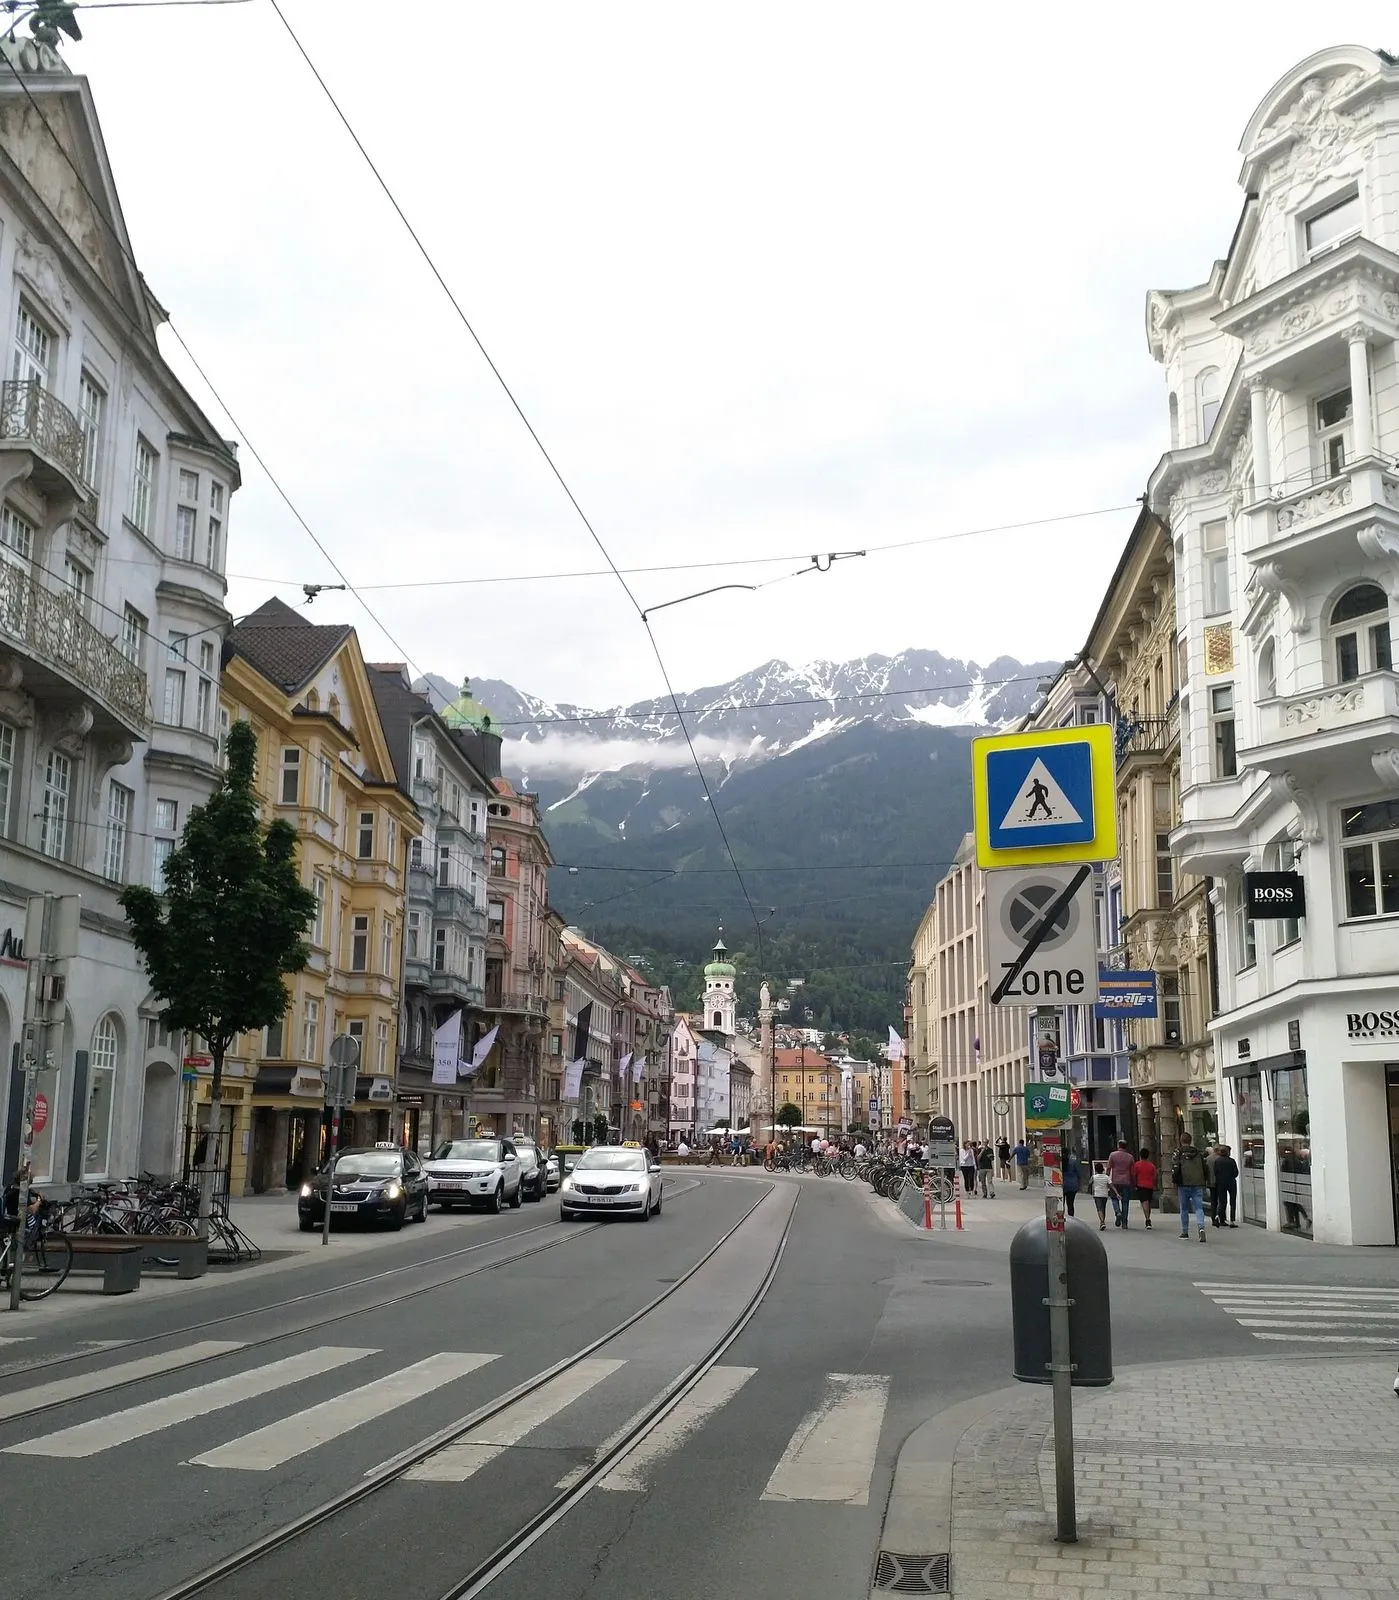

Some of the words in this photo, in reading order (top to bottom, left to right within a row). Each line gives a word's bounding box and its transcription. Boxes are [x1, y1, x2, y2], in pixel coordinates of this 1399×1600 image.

[1254, 887, 1294, 899] BOSS
[1001, 962, 1084, 995] Zone
[1098, 992, 1154, 1006] SPORTLER
